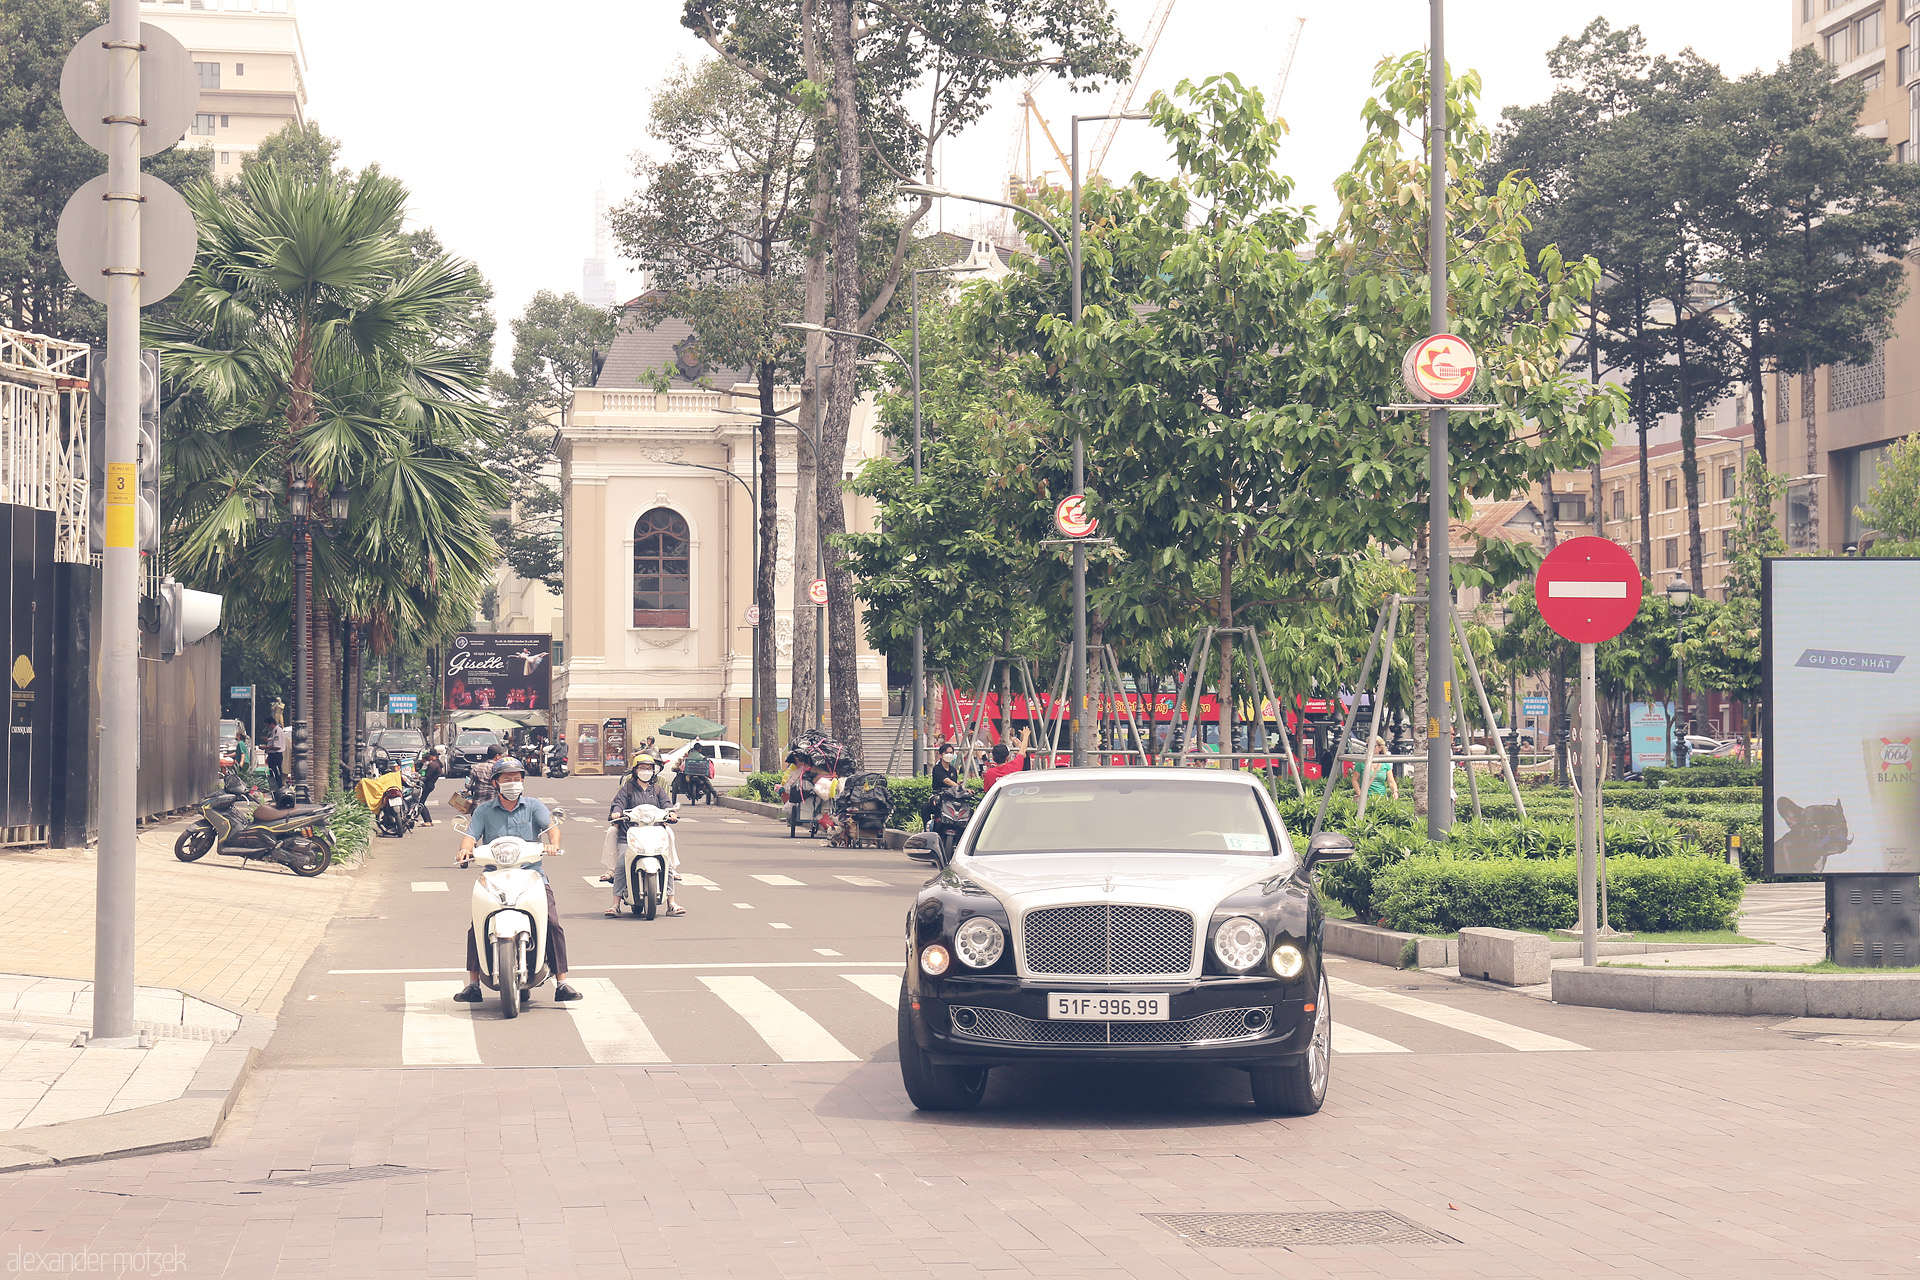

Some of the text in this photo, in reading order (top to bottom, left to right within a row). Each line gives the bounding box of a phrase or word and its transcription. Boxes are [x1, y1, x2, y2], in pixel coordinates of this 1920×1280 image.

[117, 477, 125, 490] 3
[448, 651, 505, 676] Giselle
[1809, 655, 1891, 669] GU ĐỘC NHẤT
[1884, 749, 1909, 760] 1664
[1877, 772, 1918, 782] BLANC
[1059, 998, 1158, 1015] 51F-996.99
